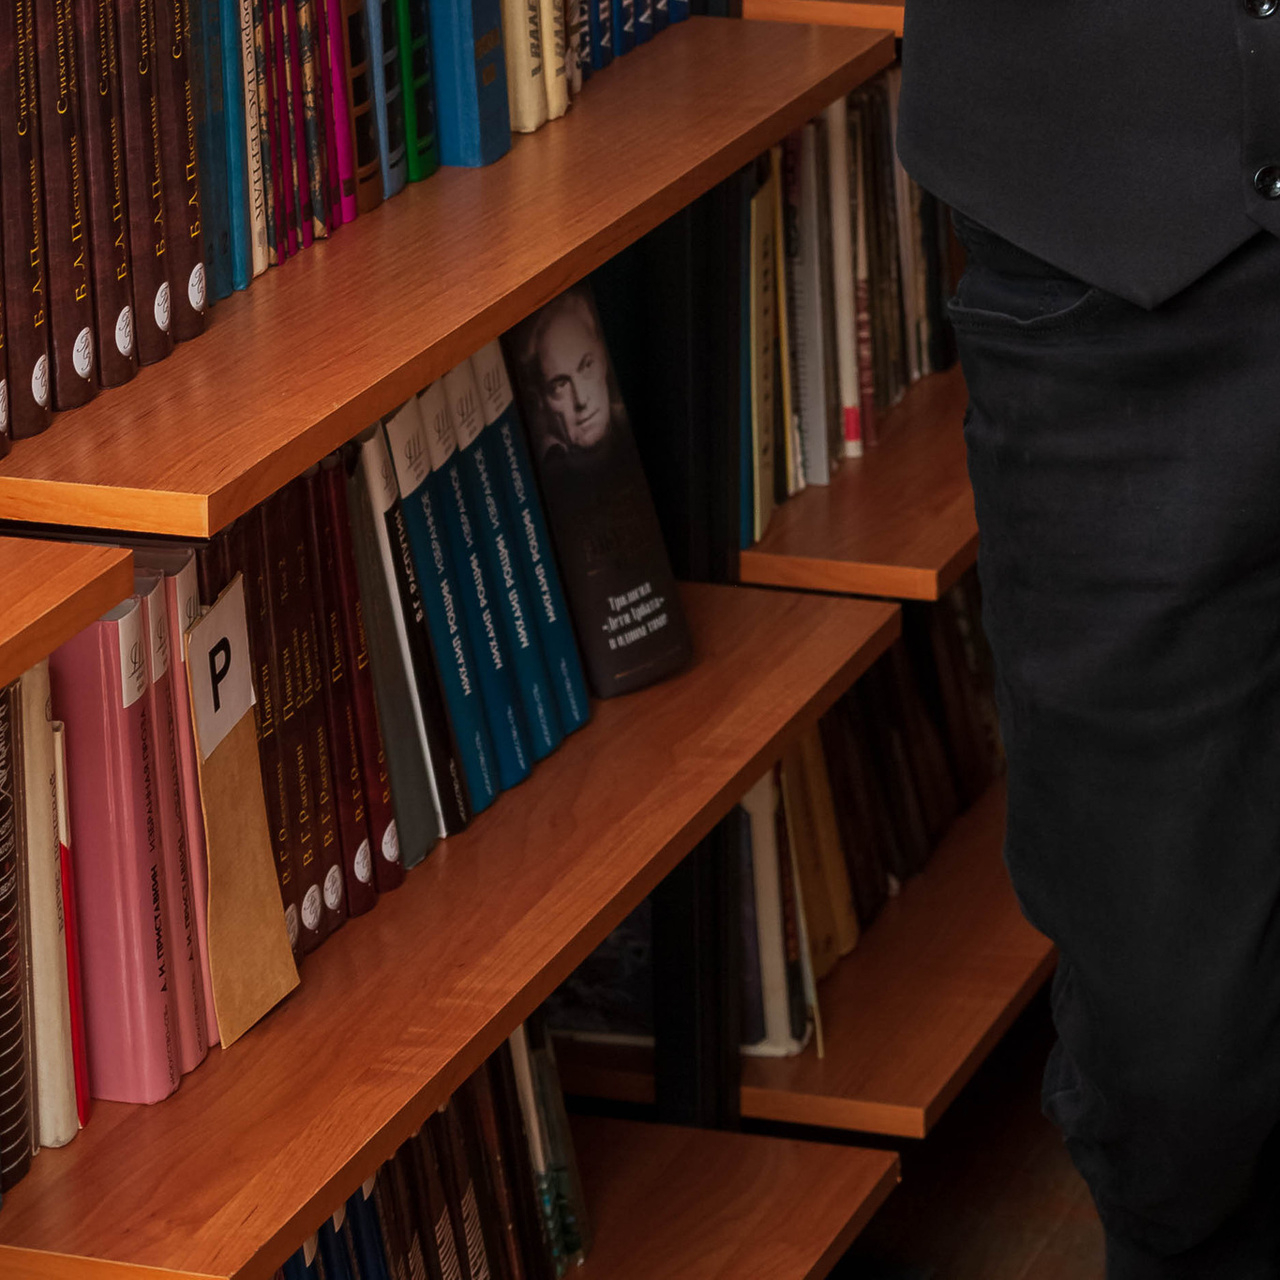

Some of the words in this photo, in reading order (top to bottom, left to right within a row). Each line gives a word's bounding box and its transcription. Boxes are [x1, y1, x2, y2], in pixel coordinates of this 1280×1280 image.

[149, 95, 163, 200] Пастернак
[184, 78, 198, 181] Пастернак
[246, 40, 264, 221] ПАСТЕРНАК
[70, 134, 82, 243] Пастернак
[110, 116, 123, 223] Пастернак
[29, 158, 40, 268] Пастернак
[156, 237, 167, 257] Б.
[190, 219, 202, 239] Б.
[75, 280, 87, 302] Б.
[117, 261, 128, 281] Б.
[33, 306, 45, 328] Б.
[473, 447, 500, 530] ИЗБРАННОЕ
[500, 421, 527, 504] ИЗБРАННОЕ
[421, 490, 445, 575] ИЗБРАННОЕ
[449, 463, 474, 548] ИЗБРАННОЕ
[521, 507, 541, 562] РОЩИН
[469, 552, 488, 608] РОЩИН
[495, 532, 515, 588] РОЩИН
[534, 562, 557, 624] МИХАИЛ
[440, 578, 458, 635] РОЩИН
[482, 608, 503, 670] МИХАИЛ
[508, 588, 530, 649] МИХАИЛ
[207, 636, 232, 714] Р
[281, 646, 295, 721] Повести
[301, 629, 314, 705] Повести
[452, 635, 472, 697] МИХАИЛ
[261, 663, 274, 739] Повести
[139, 709, 151, 762] ПРОЗА
[145, 765, 159, 853] ИЗБРАННАЯ
[149, 864, 166, 958] ПРИСТАВКИН
[158, 959, 167, 977] И.
[160, 978, 168, 993] А.
